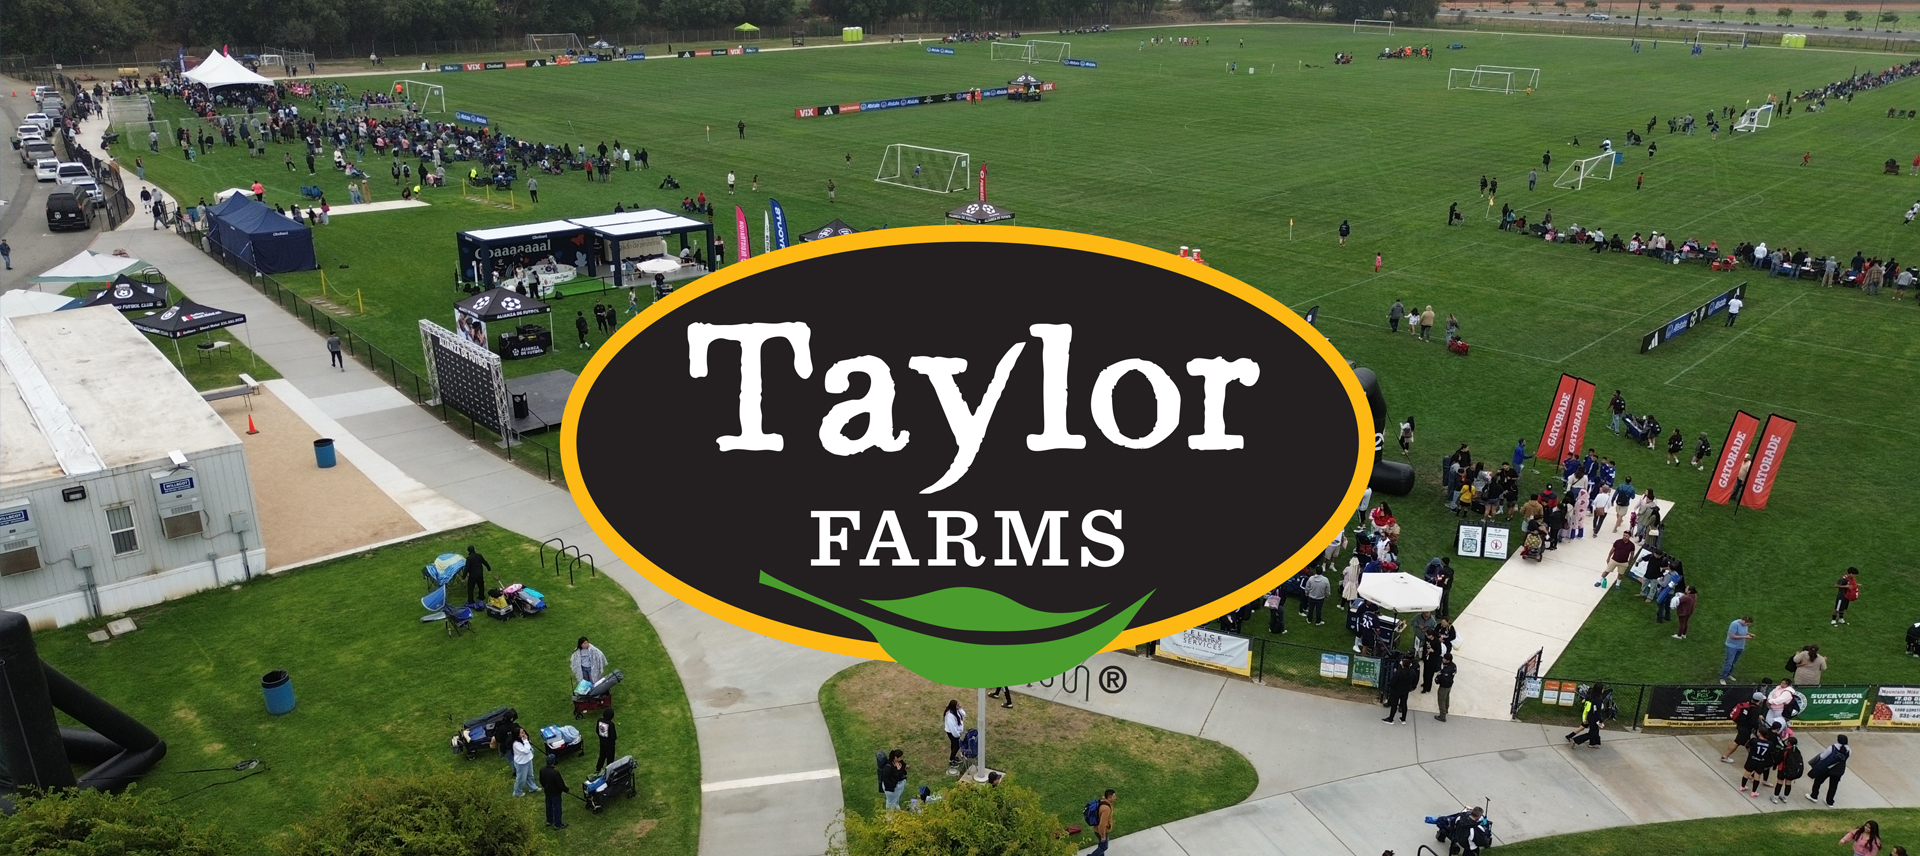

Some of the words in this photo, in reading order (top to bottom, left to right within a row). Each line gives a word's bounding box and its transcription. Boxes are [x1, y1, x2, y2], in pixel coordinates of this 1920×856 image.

[1547, 392, 1571, 448] GATORADE
[1568, 397, 1586, 453] GATORADE
[1717, 430, 1747, 489] GATORADE
[1752, 434, 1782, 494] GATORADE
[1756, 745, 1768, 756] 17
